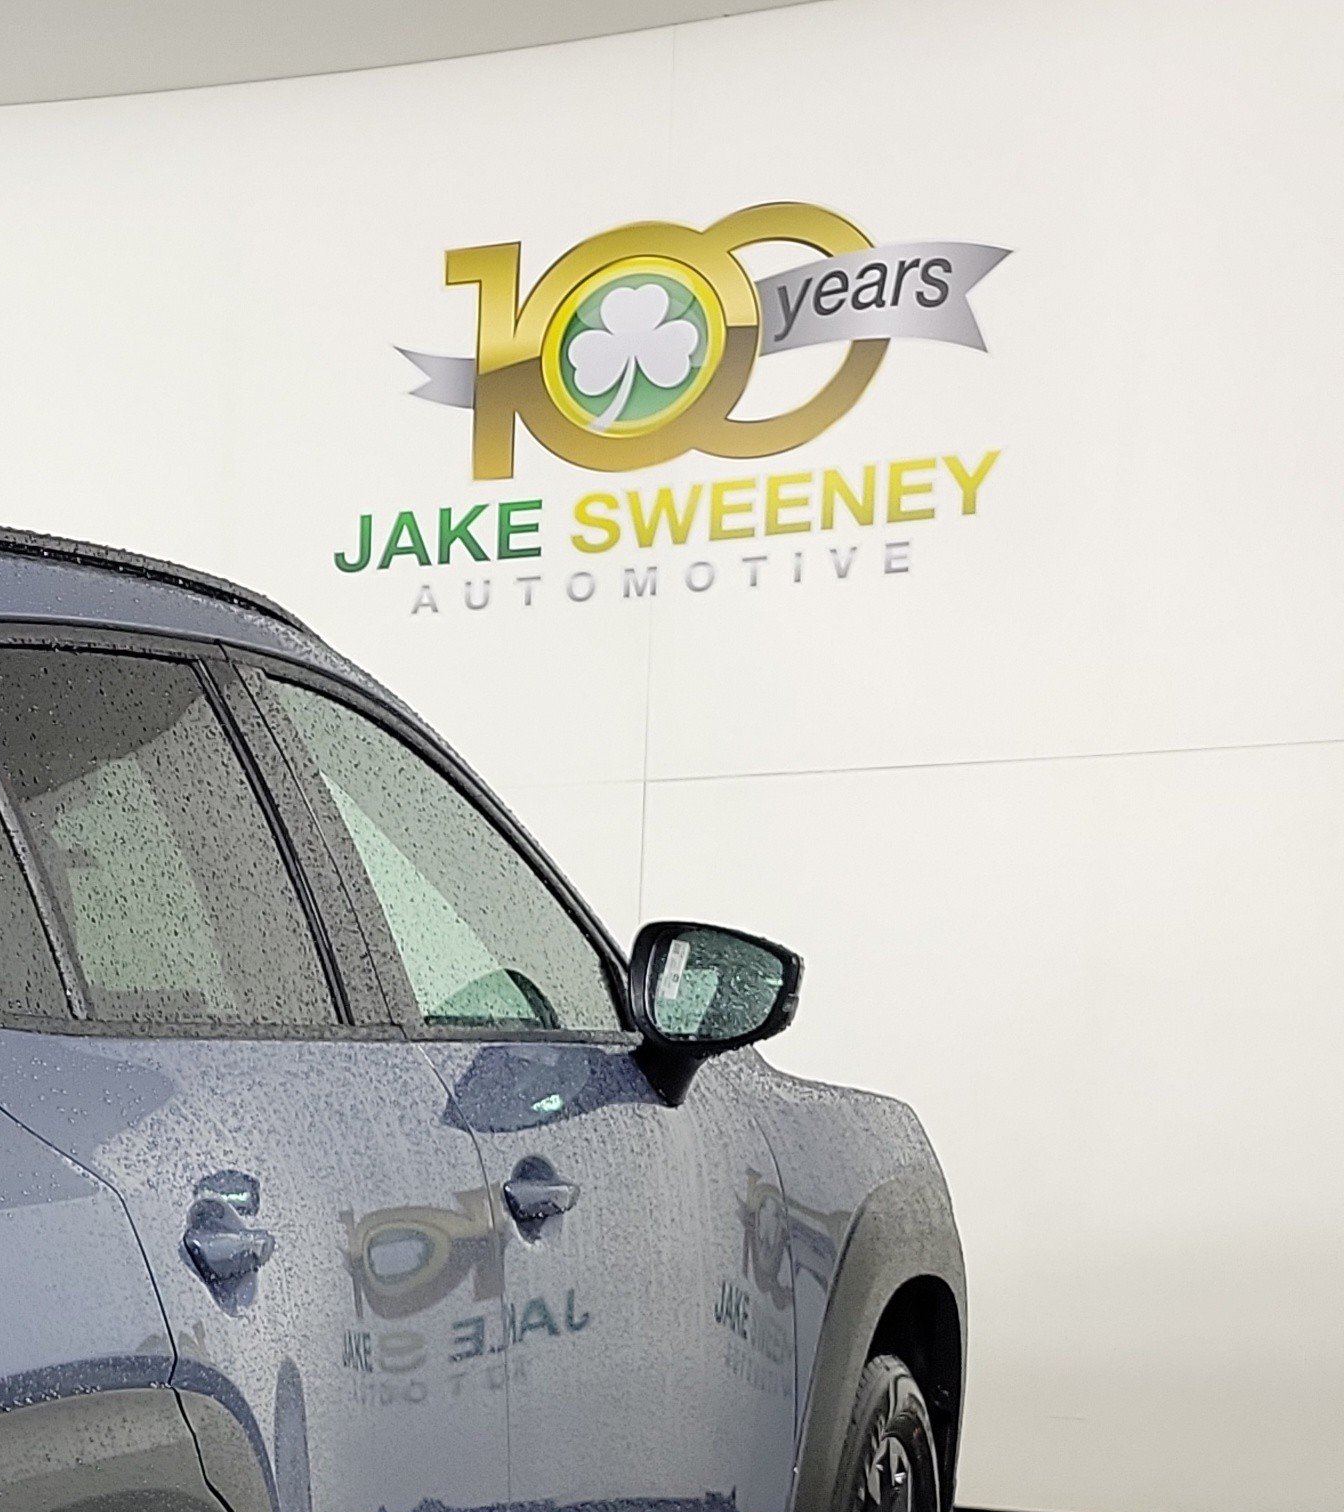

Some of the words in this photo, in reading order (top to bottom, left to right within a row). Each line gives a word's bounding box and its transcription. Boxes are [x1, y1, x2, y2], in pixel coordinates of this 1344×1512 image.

[443, 200, 891, 481] 100
[773, 255, 954, 343] years
[333, 500, 544, 574] JAKE
[570, 450, 1002, 555] SWEENEY
[411, 541, 912, 615] AUTOMOTIVE
